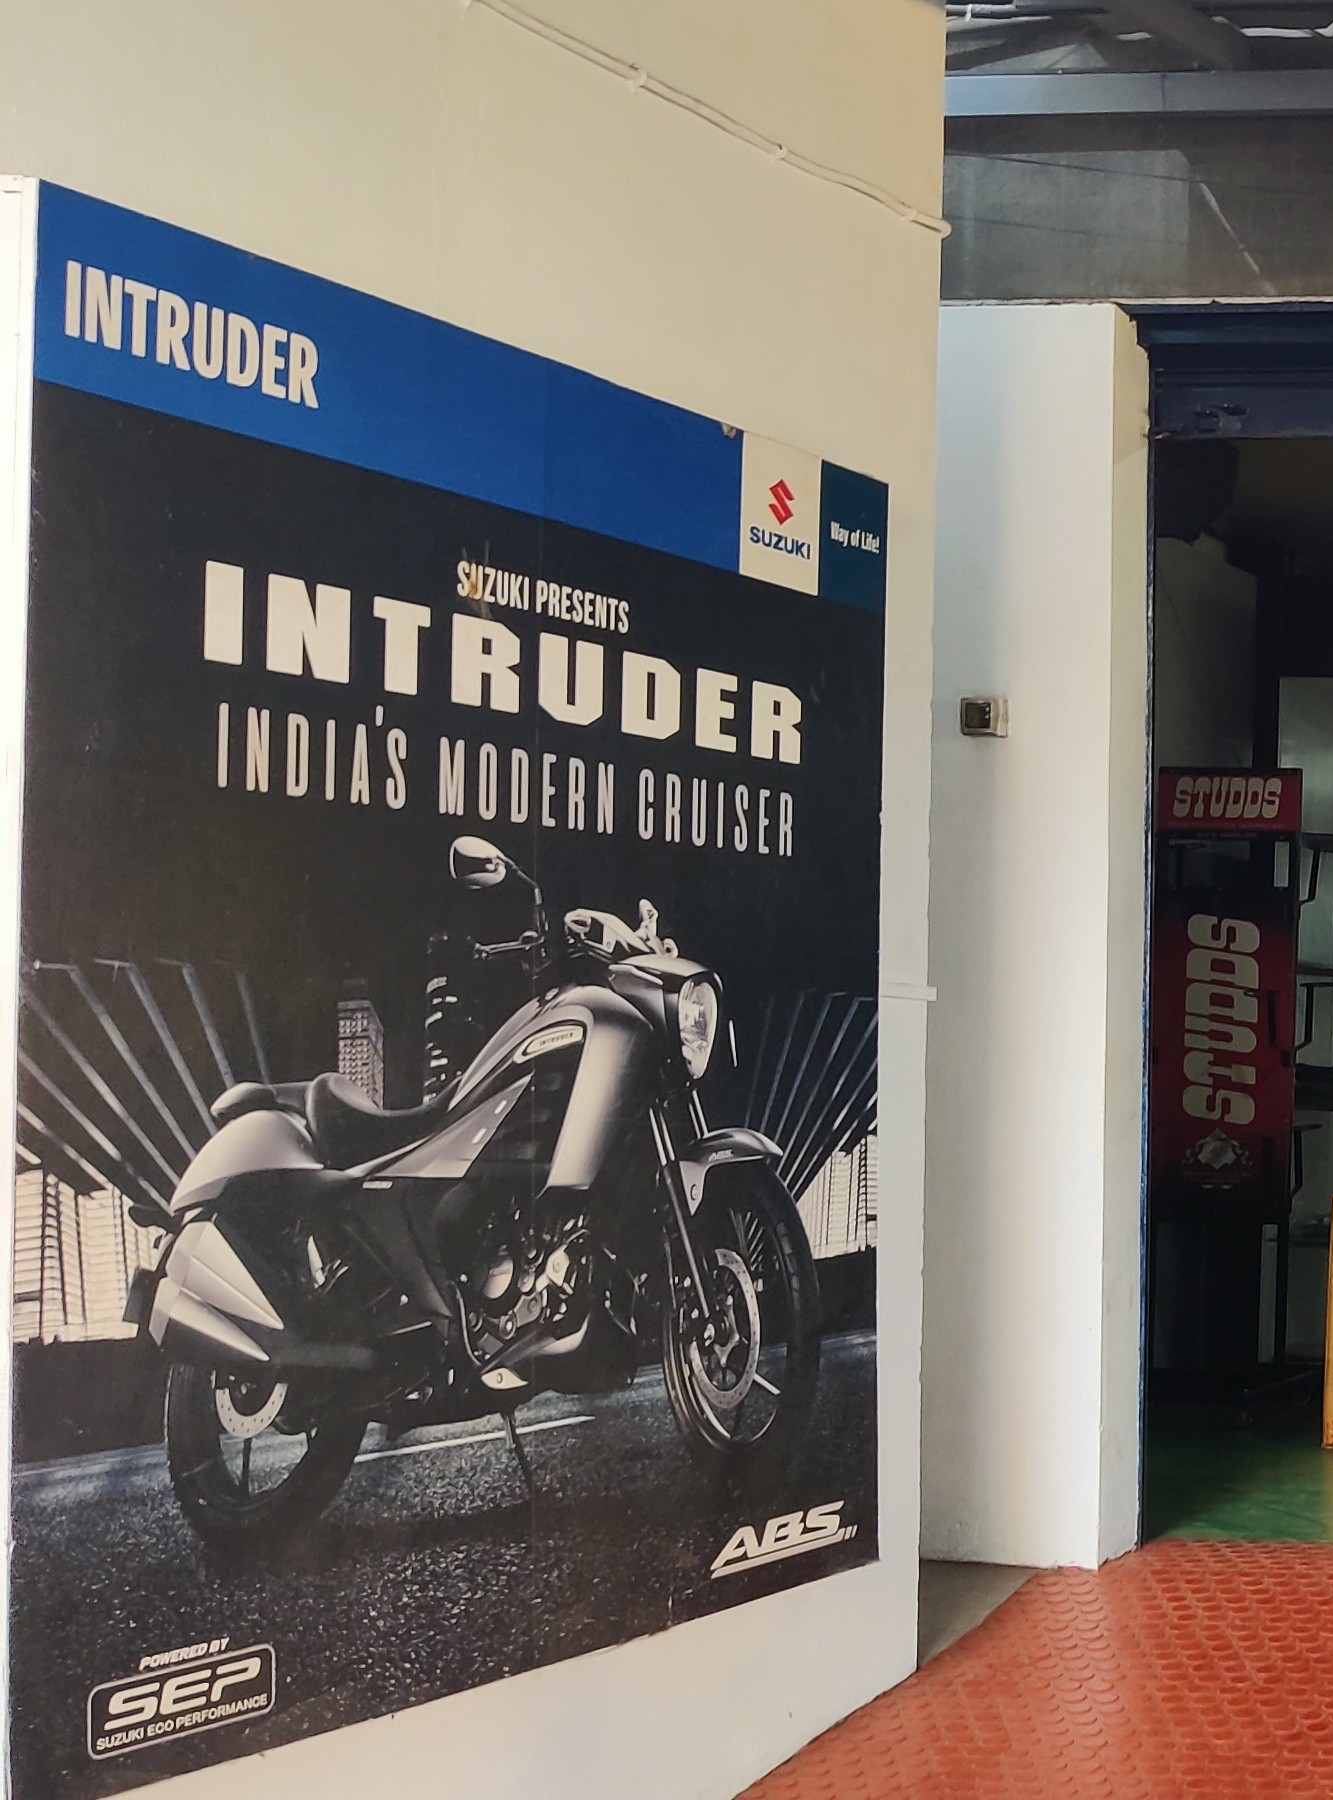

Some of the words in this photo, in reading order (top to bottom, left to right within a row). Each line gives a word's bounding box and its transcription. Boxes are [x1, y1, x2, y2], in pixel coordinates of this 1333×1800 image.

[64, 260, 319, 409] INTRUDER
[749, 526, 811, 560] SUZUKI
[830, 521, 849, 547] Way
[850, 529, 860, 547] of
[861, 531, 880, 554] Life!
[457, 561, 530, 611] SUZUKI
[535, 579, 629, 634] PRESENTS
[204, 560, 801, 765] INTRUDER
[218, 702, 407, 810] INDIA'S
[439, 737, 615, 835] MODERN
[638, 768, 794, 857] CRUISER
[1173, 776, 1282, 818] STUDDS
[1182, 913, 1260, 1125] STUDDS
[710, 1500, 845, 1570] ABS
[139, 1643, 208, 1671] POWERED
[209, 1637, 230, 1653] BY
[96, 1726, 144, 1751] SUZUKI
[147, 1720, 174, 1738] ECO
[175, 1693, 267, 1731] PERFORMANCE
[104, 1657, 261, 1730] SEP
